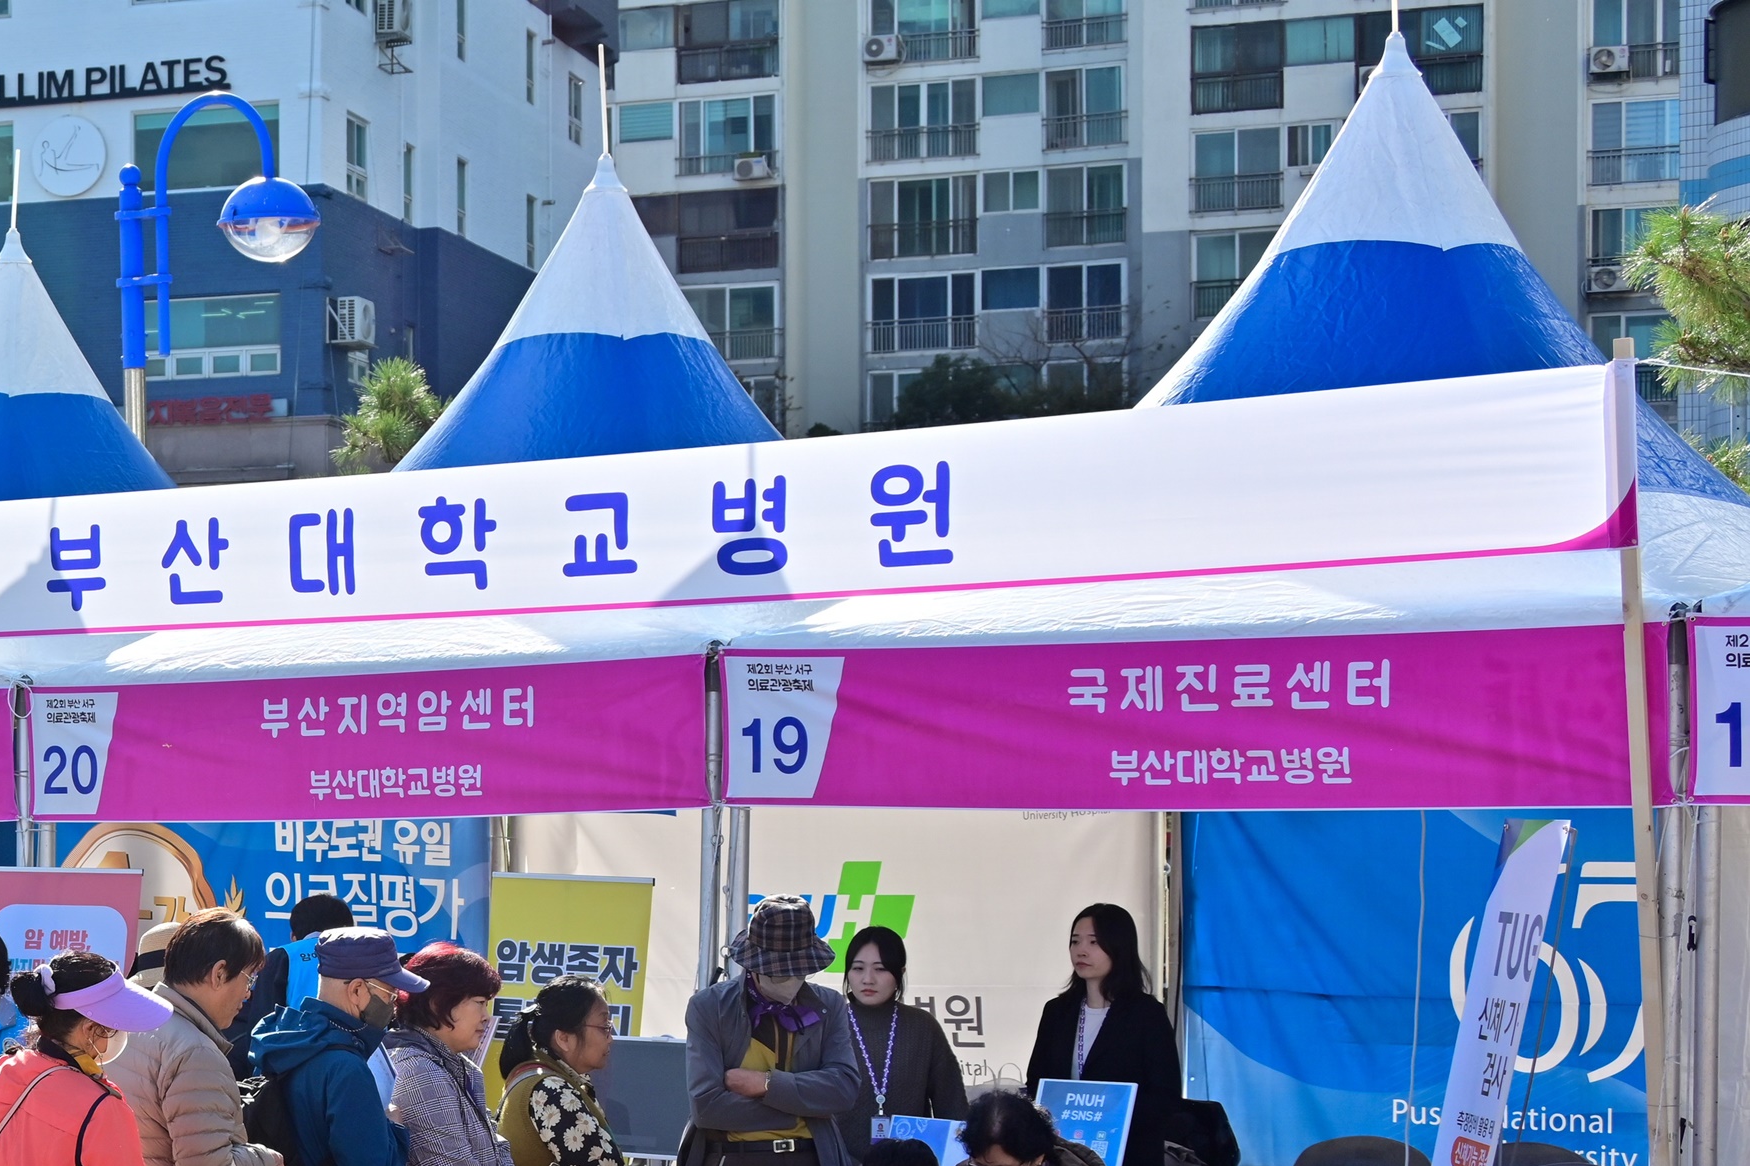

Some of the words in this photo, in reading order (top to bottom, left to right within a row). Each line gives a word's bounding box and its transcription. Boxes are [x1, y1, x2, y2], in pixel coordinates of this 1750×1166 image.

[84, 55, 229, 97] PILATES
[46, 460, 956, 611] 부산대학교병원
[1725, 633, 1750, 648] 제2
[746, 663, 773, 675] 제2회
[775, 663, 793, 676] 부산
[795, 663, 813, 676] 서구
[747, 678, 815, 692] 의료관광축제
[1066, 658, 1393, 714] 국제진료센터
[46, 698, 67, 709] 제2회
[67, 699, 81, 709] 부산
[81, 699, 96, 709] 서구
[46, 711, 97, 724] 의료관광축제
[260, 685, 535, 739] 부산지역암센터
[742, 716, 809, 775] 19
[1109, 745, 1353, 787] 부산대학교병원
[43, 744, 98, 795] 20
[309, 763, 483, 801] 부산대학교병원
[274, 820, 383, 862] 비수도권
[393, 820, 451, 867] 유일
[24, 928, 45, 950] 암
[49, 929, 91, 952] 예방,
[1493, 911, 1544, 983] TUG
[497, 938, 640, 990] 암생존자
[1478, 997, 1506, 1044] 신체
[1481, 1052, 1508, 1100] 검사
[1061, 1109, 1103, 1122] #SNS#
[1065, 1093, 1106, 1108] PNUH
[1392, 1098, 1441, 1126] Pus
